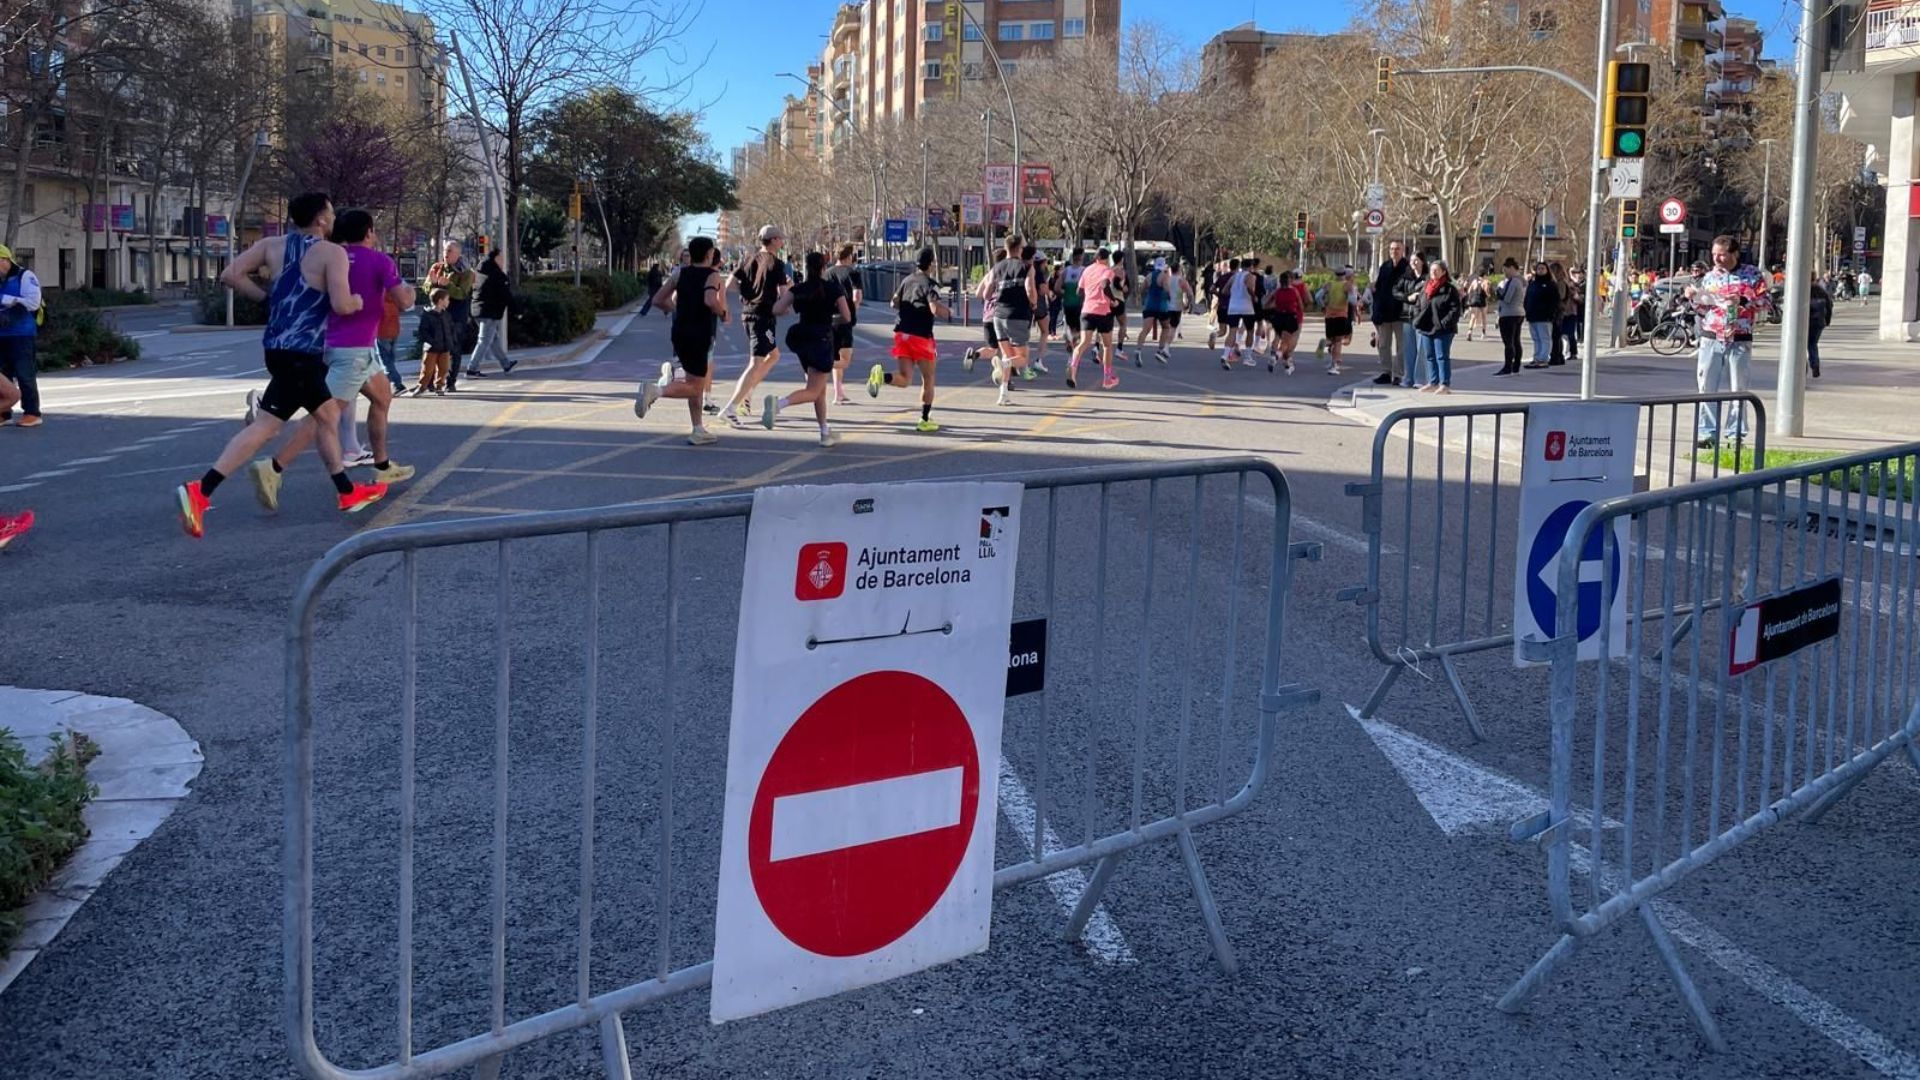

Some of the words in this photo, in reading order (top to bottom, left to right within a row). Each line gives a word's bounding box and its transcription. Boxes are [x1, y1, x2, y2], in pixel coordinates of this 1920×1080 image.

[1666, 207, 1679, 217] 30
[1568, 435, 1611, 447] Ajuntament
[1567, 448, 1577, 458] de
[1578, 447, 1614, 458] Barcelona
[857, 543, 961, 570] Ajuntament
[856, 570, 878, 590] de
[883, 566, 971, 589] Barcelona
[1762, 616, 1801, 640] Ajuntament
[1807, 602, 1838, 622] Barcelona
